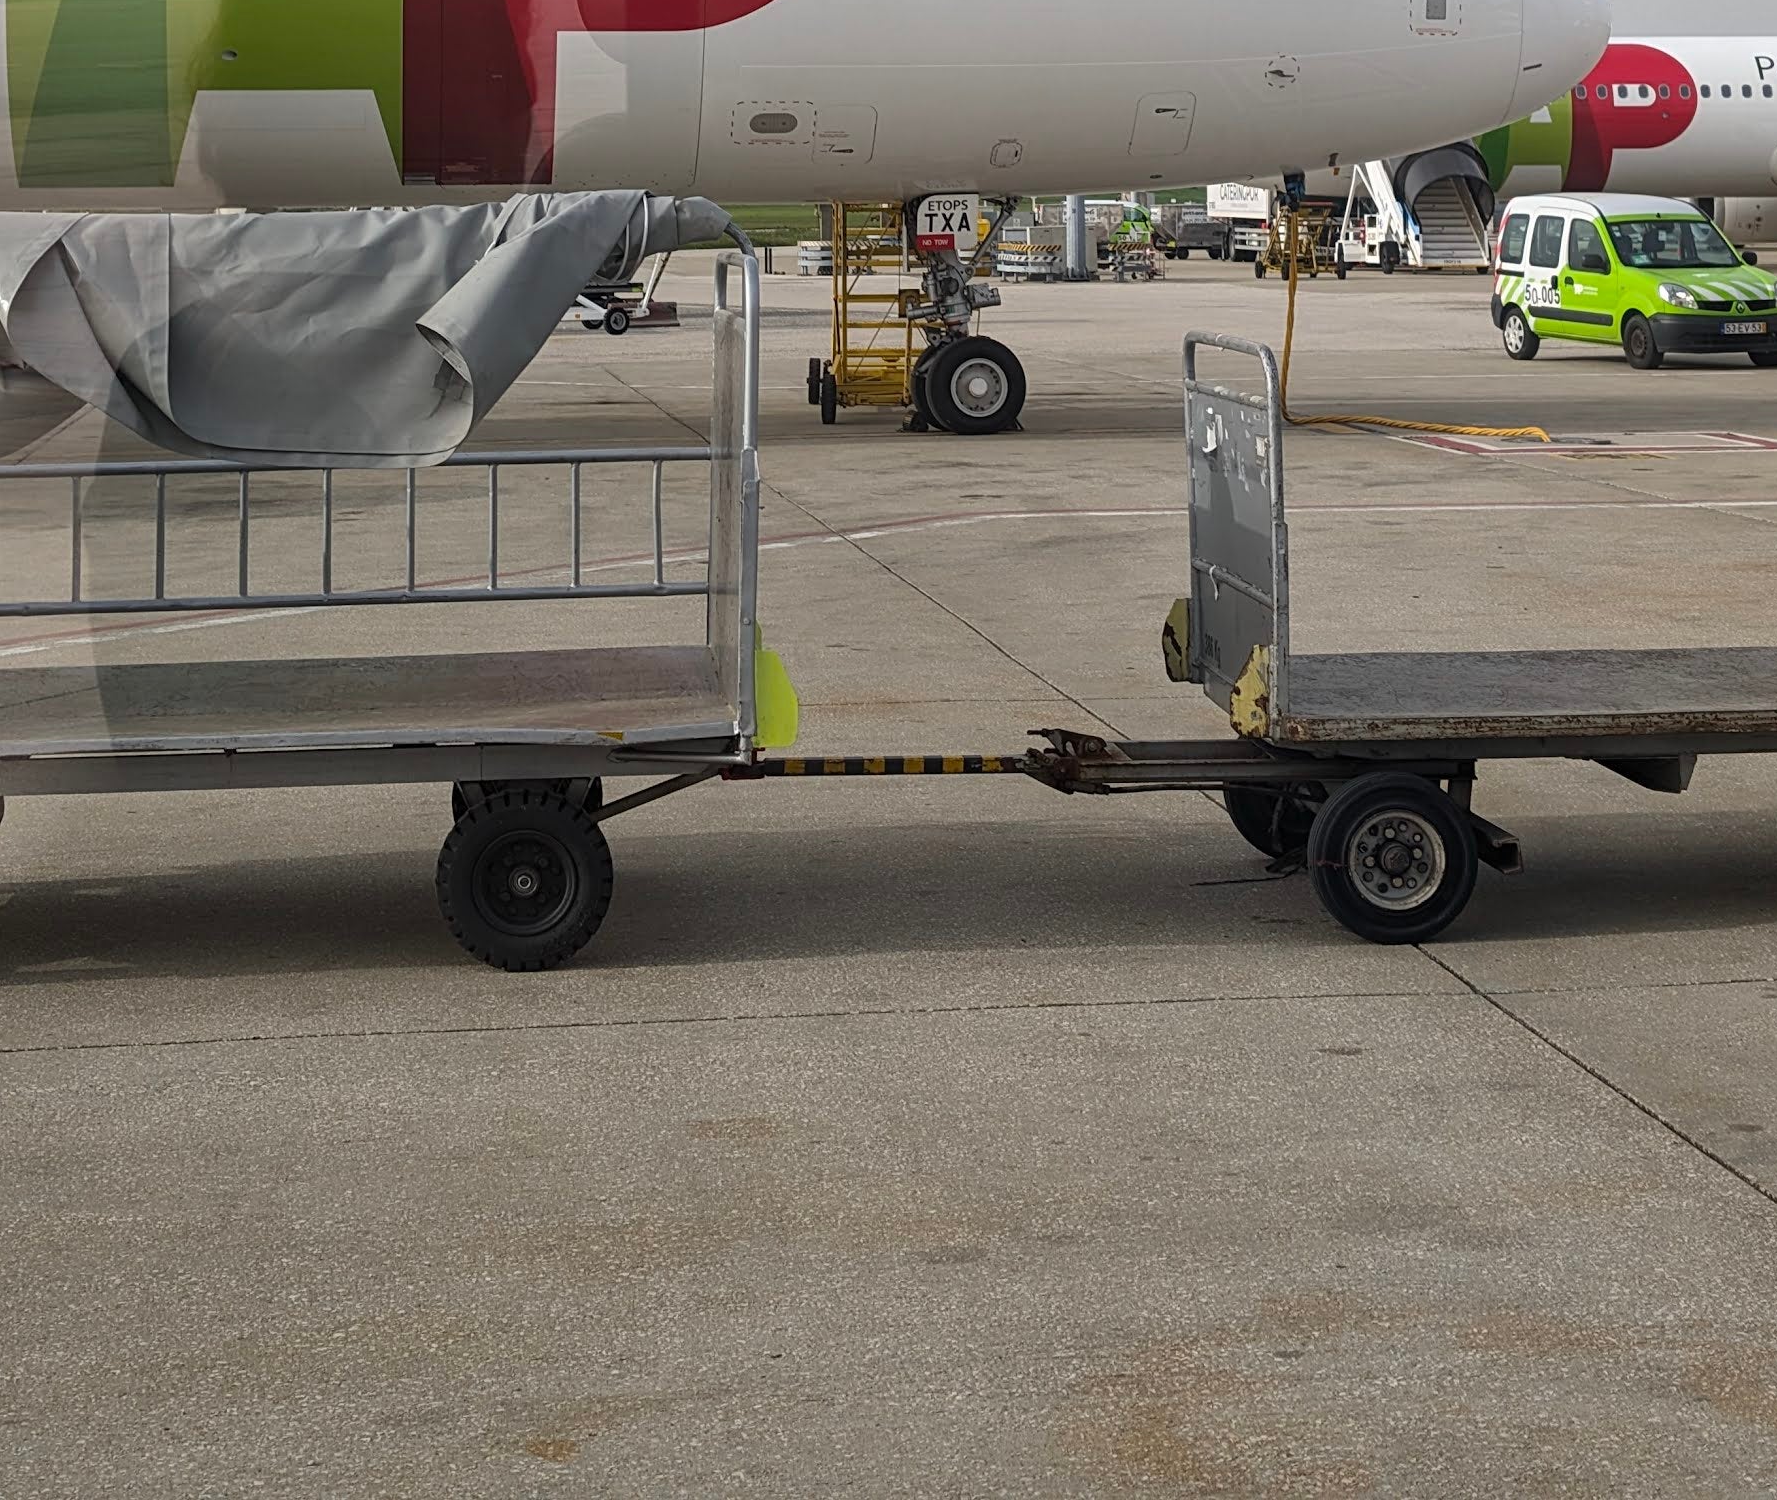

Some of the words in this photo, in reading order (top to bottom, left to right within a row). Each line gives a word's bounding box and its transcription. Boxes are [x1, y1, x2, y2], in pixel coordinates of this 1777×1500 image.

[928, 200, 968, 211] ETOPS
[925, 213, 971, 232] TXA
[1525, 284, 1560, 304] 50-005
